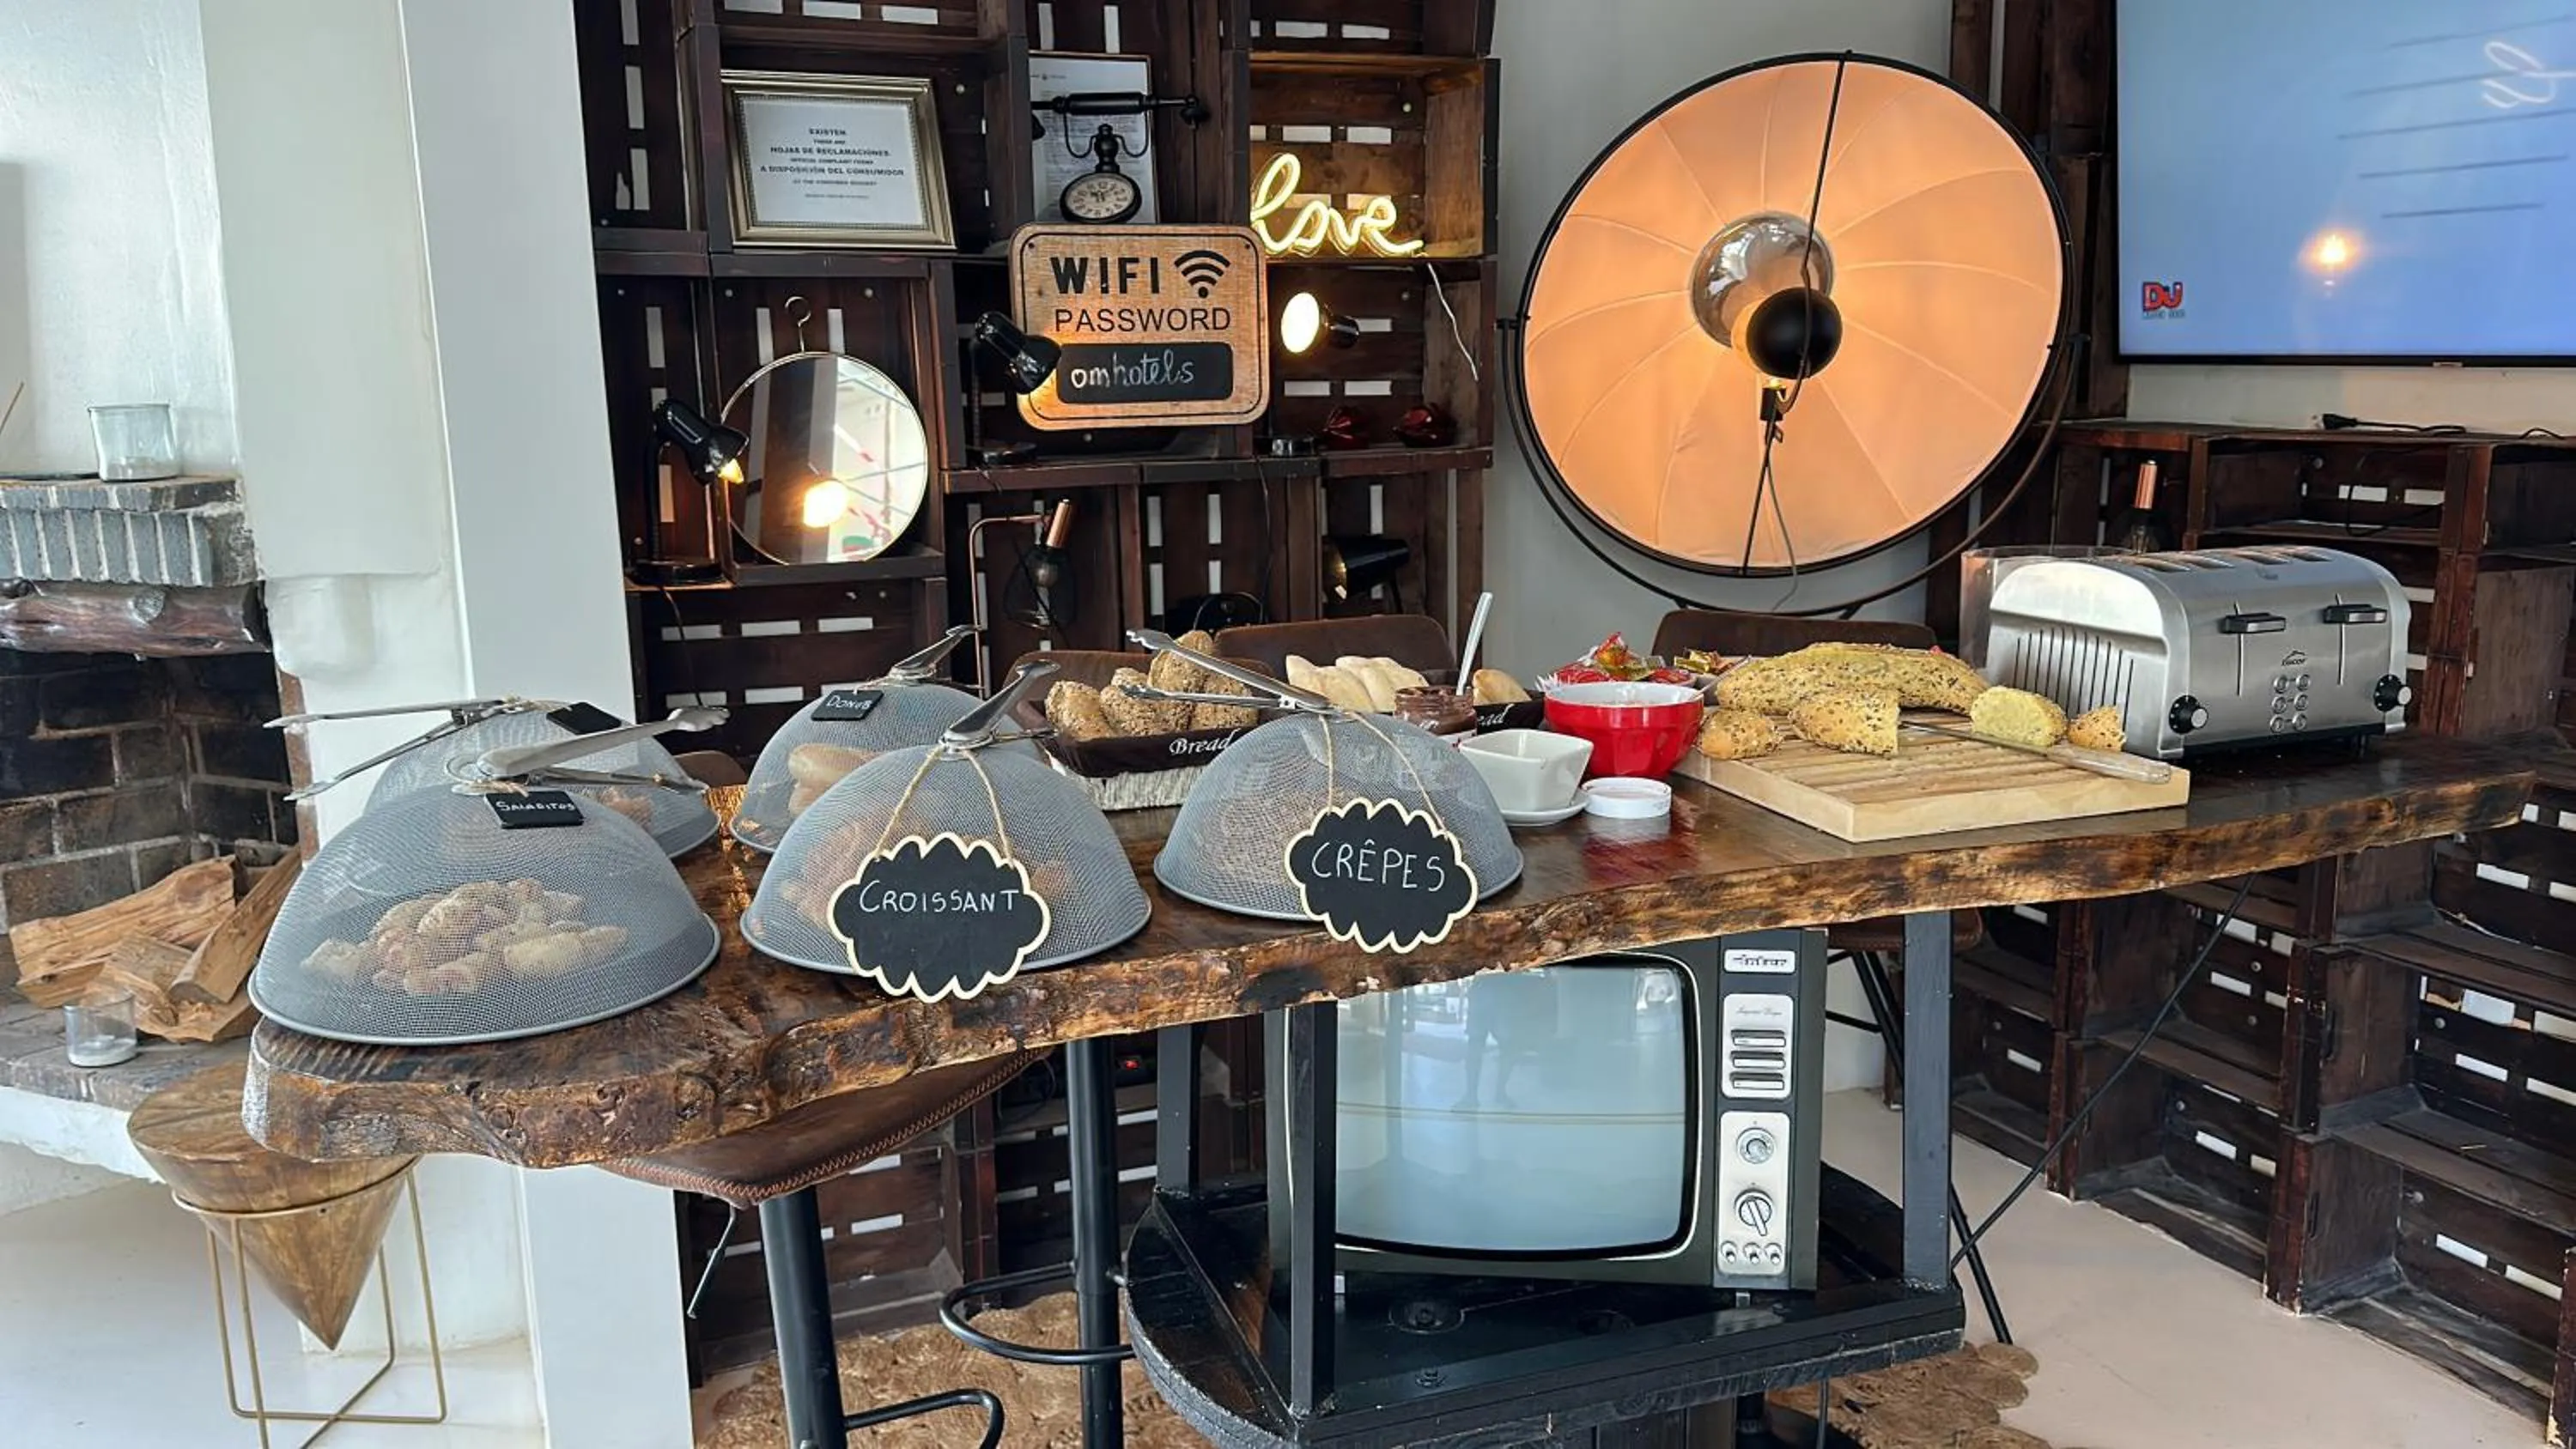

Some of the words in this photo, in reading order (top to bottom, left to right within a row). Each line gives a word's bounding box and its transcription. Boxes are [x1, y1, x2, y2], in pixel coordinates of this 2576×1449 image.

[1250, 153, 1425, 257] love
[1049, 257, 1161, 294] WIFI
[2142, 282, 2184, 312] DJ
[1054, 306, 1231, 332] PASSWORD
[1169, 727, 1242, 756] Bread
[1311, 838, 1446, 893] CRÊPES
[859, 879, 1020, 913] CROISSANT
